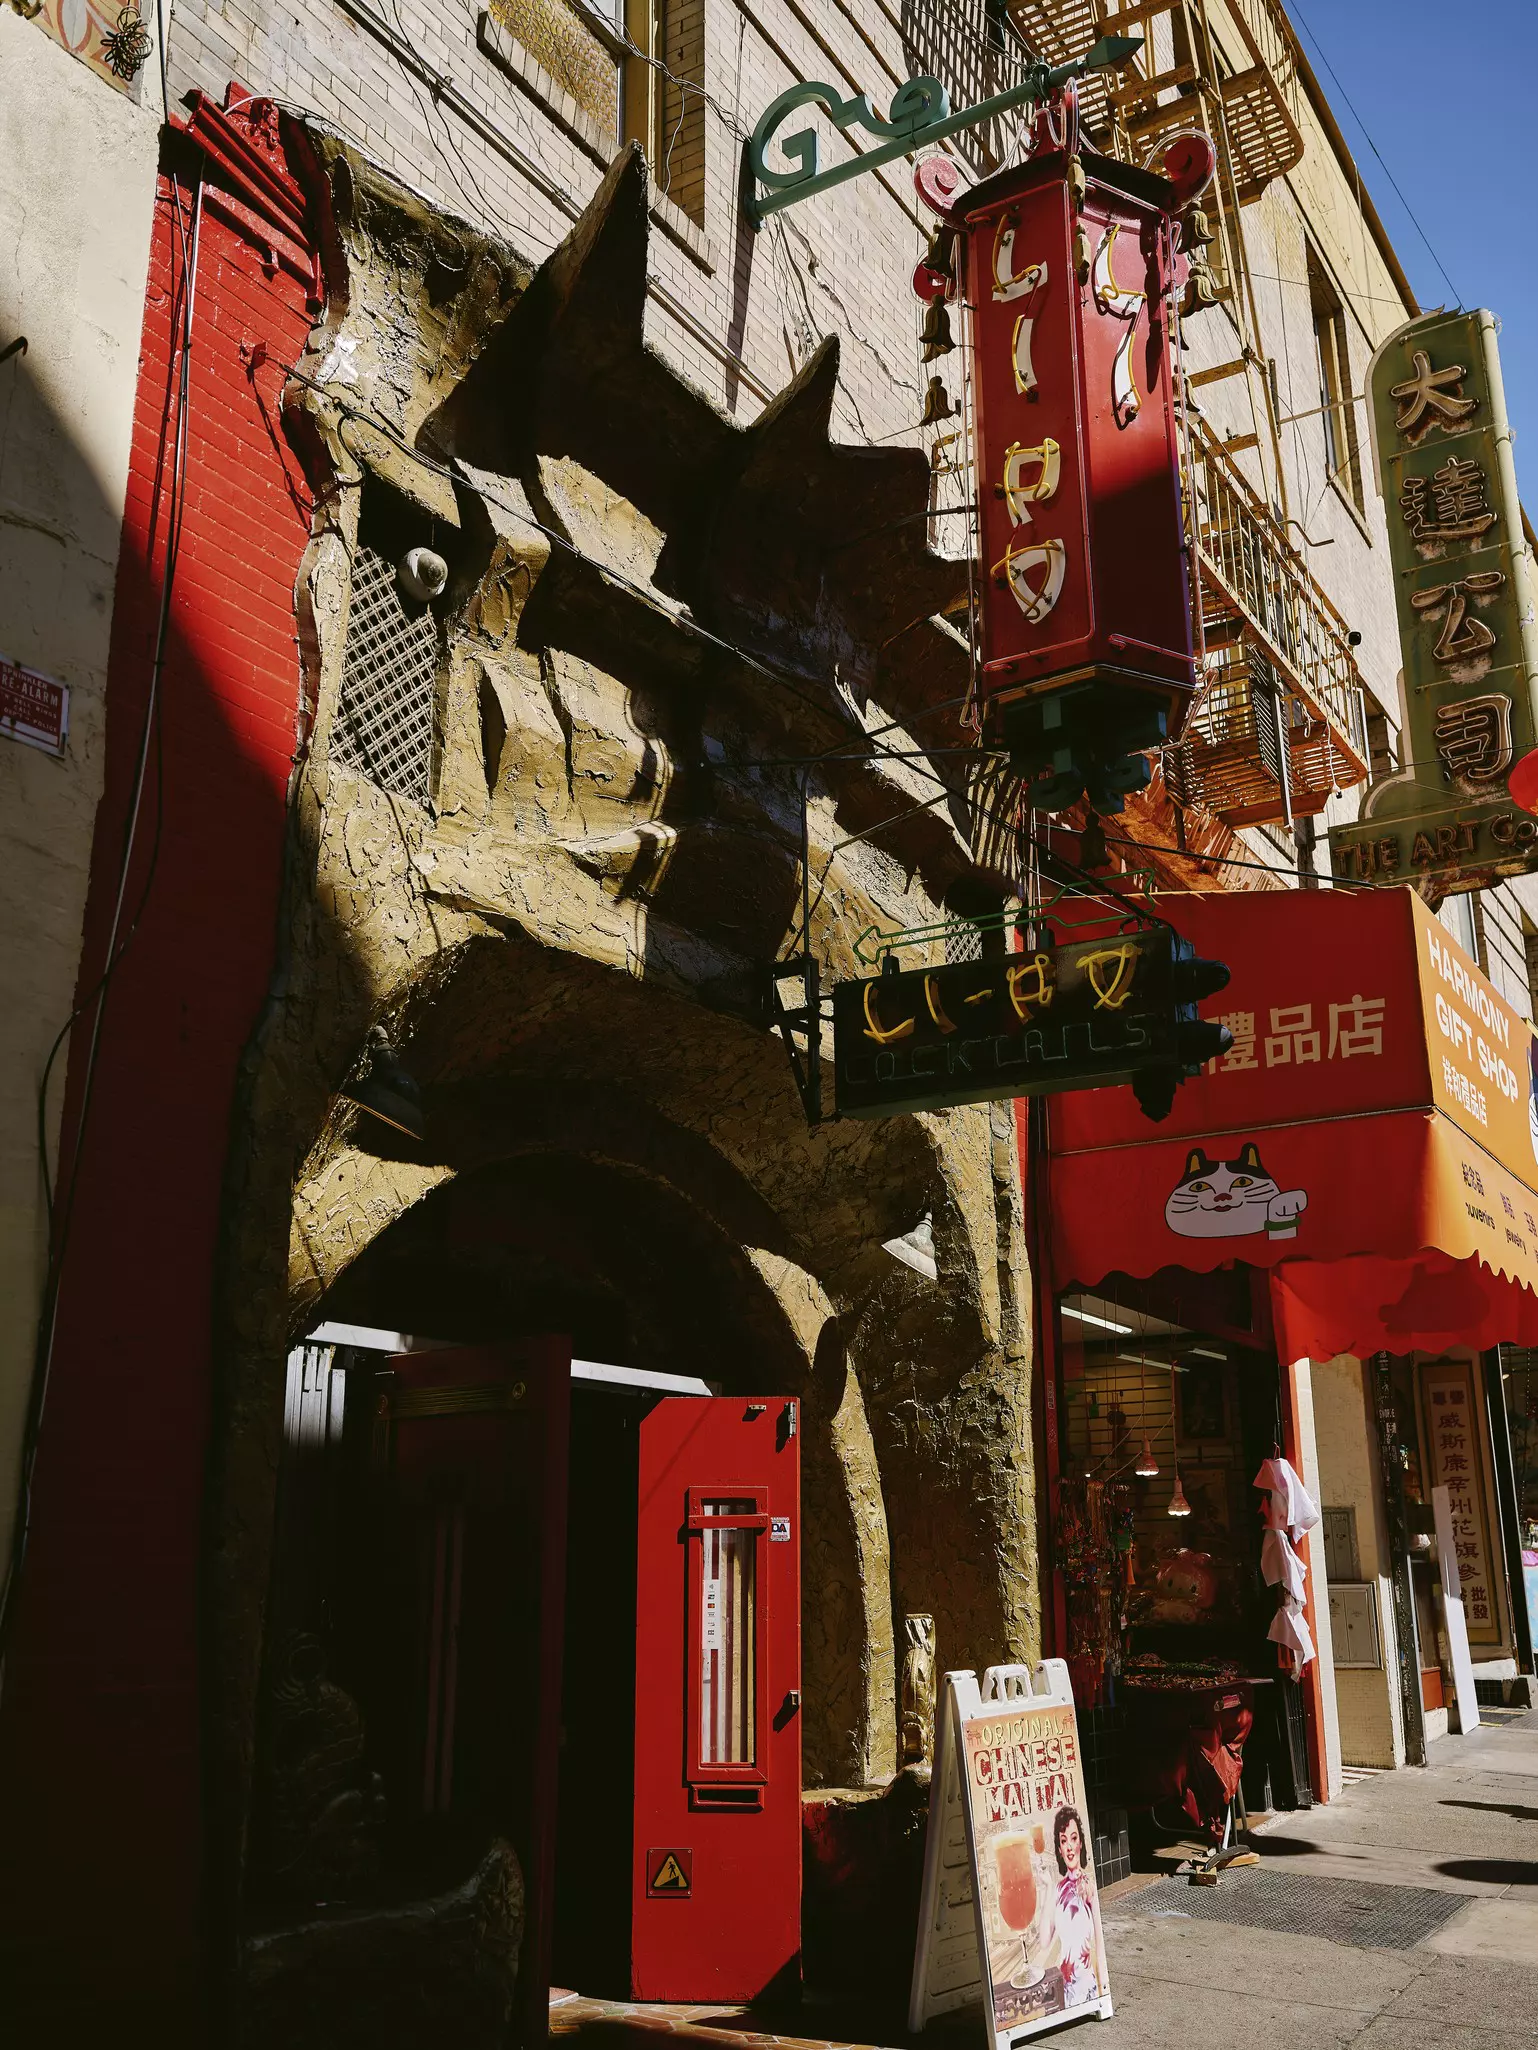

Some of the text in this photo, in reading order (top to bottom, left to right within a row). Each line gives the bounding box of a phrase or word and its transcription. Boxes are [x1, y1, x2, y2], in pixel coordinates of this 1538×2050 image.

[1390, 350, 1513, 782] 大達公司
[1333, 836, 1400, 878] THE
[1411, 820, 1480, 866] ART
[1427, 927, 1509, 1050] HARMONY
[1435, 992, 1519, 1104] GIFT SHOP
[981, 1715, 1064, 1747] ORIGINAL
[973, 1735, 1077, 1786] CHINESE
[985, 1772, 1076, 1823] MAI TAI
